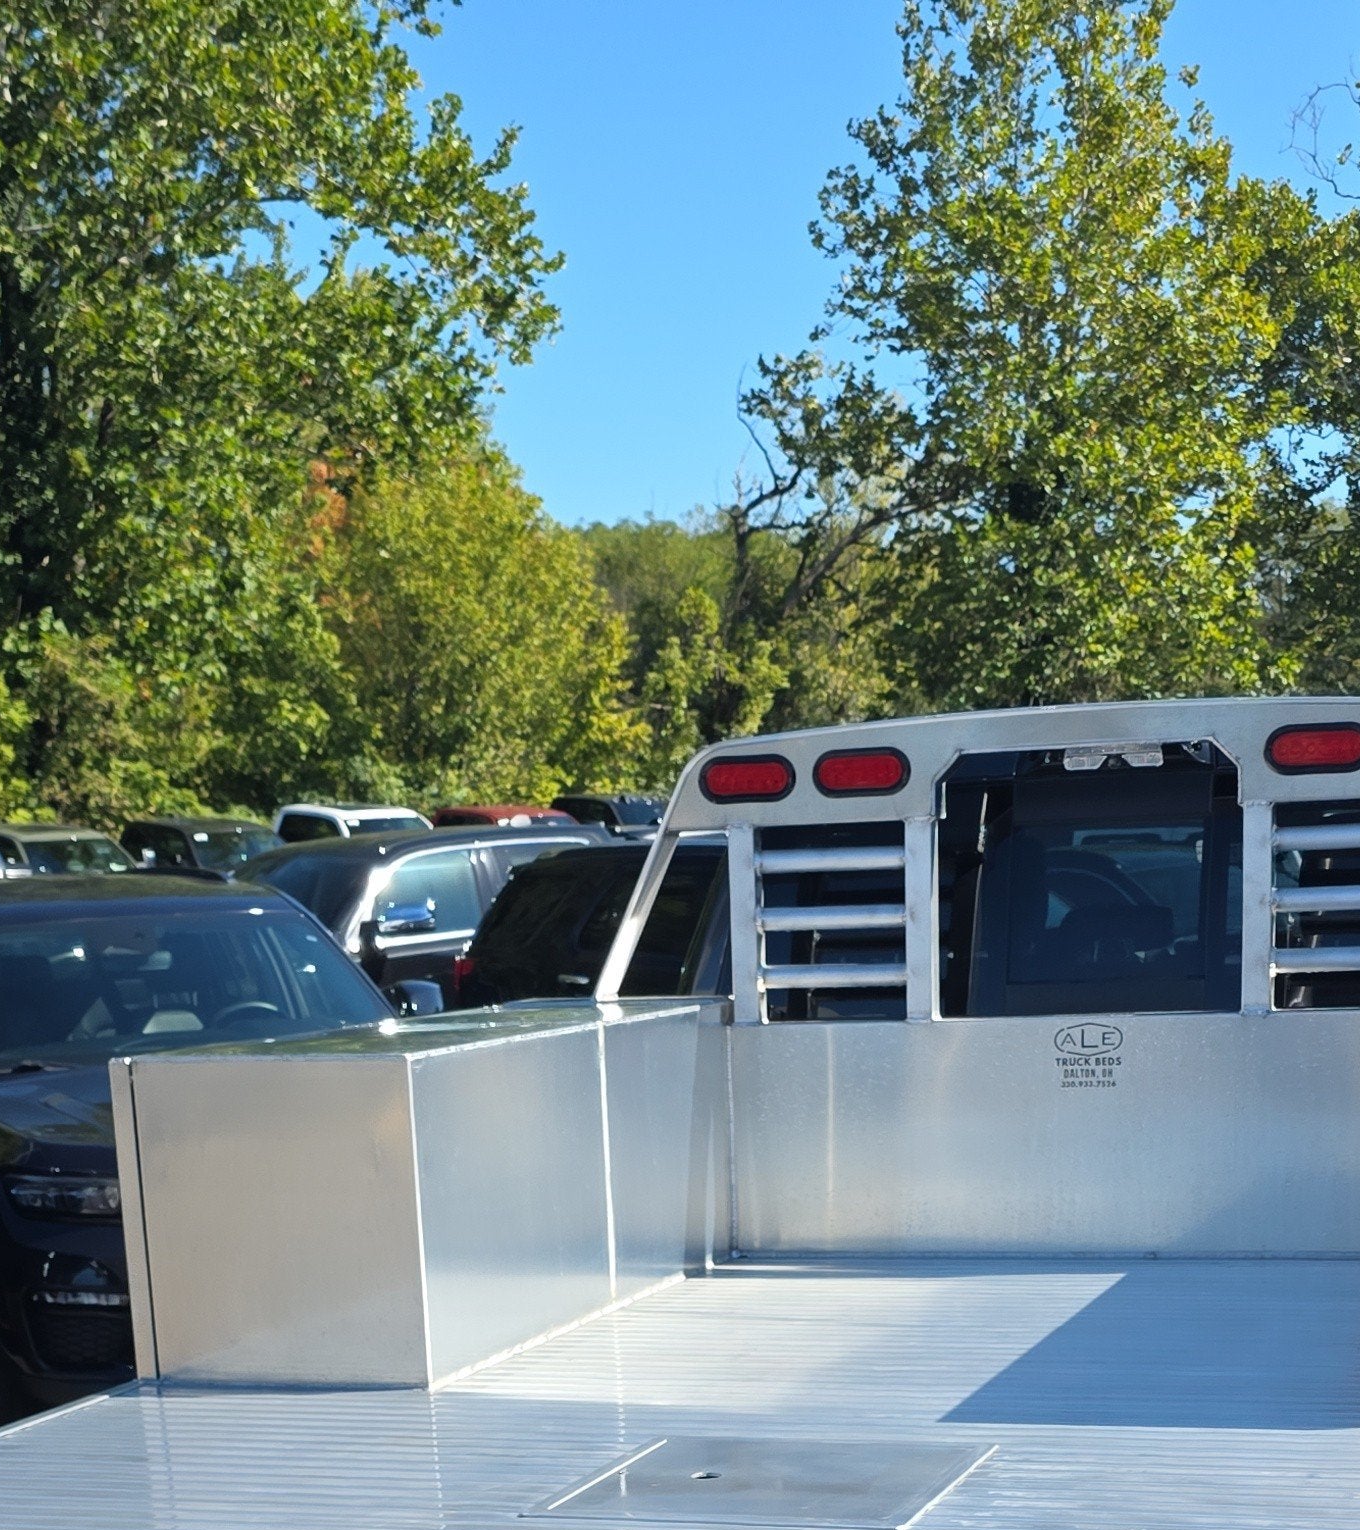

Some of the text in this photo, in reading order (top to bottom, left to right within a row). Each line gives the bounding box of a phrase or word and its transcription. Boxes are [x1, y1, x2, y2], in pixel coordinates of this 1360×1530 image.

[1060, 1028, 1116, 1049] ALE
[1055, 1056, 1122, 1067] TRUCK BEDS
[1063, 1068, 1100, 1079] DALTON,
